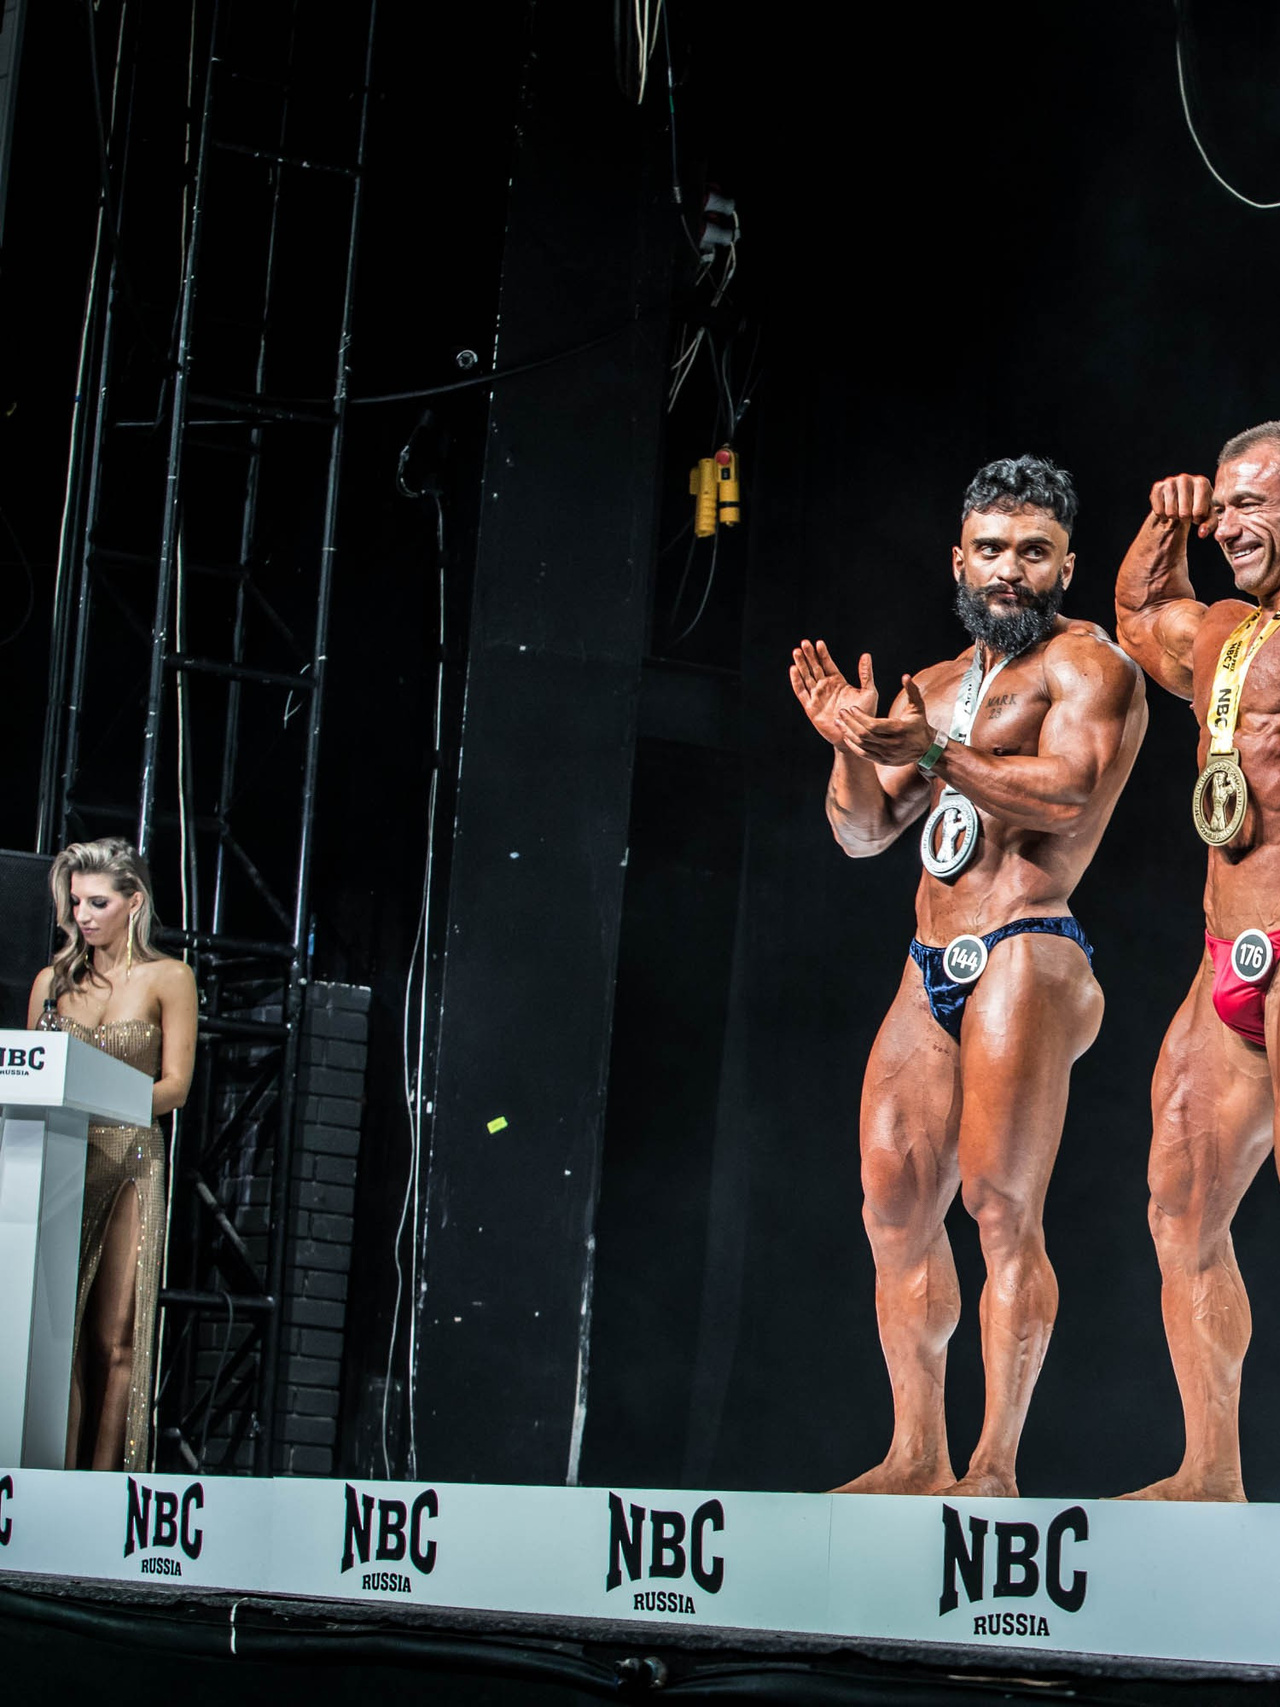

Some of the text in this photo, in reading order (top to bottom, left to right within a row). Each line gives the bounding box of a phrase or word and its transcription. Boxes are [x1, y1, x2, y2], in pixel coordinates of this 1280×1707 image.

[1214, 688, 1232, 728] NBC
[950, 946, 978, 972] 144
[1239, 943, 1264, 969] 176
[0, 1047, 45, 1071] BC
[124, 1475, 204, 1560] NBC
[341, 1482, 439, 1575] NBC
[606, 1491, 726, 1595] NBC
[141, 1558, 182, 1577] RUSSIA
[939, 1502, 1090, 1615] NBC
[361, 1572, 412, 1593] RUSSIA
[633, 1591, 696, 1615] RUSSIA
[973, 1612, 1051, 1637] RUSSIA
